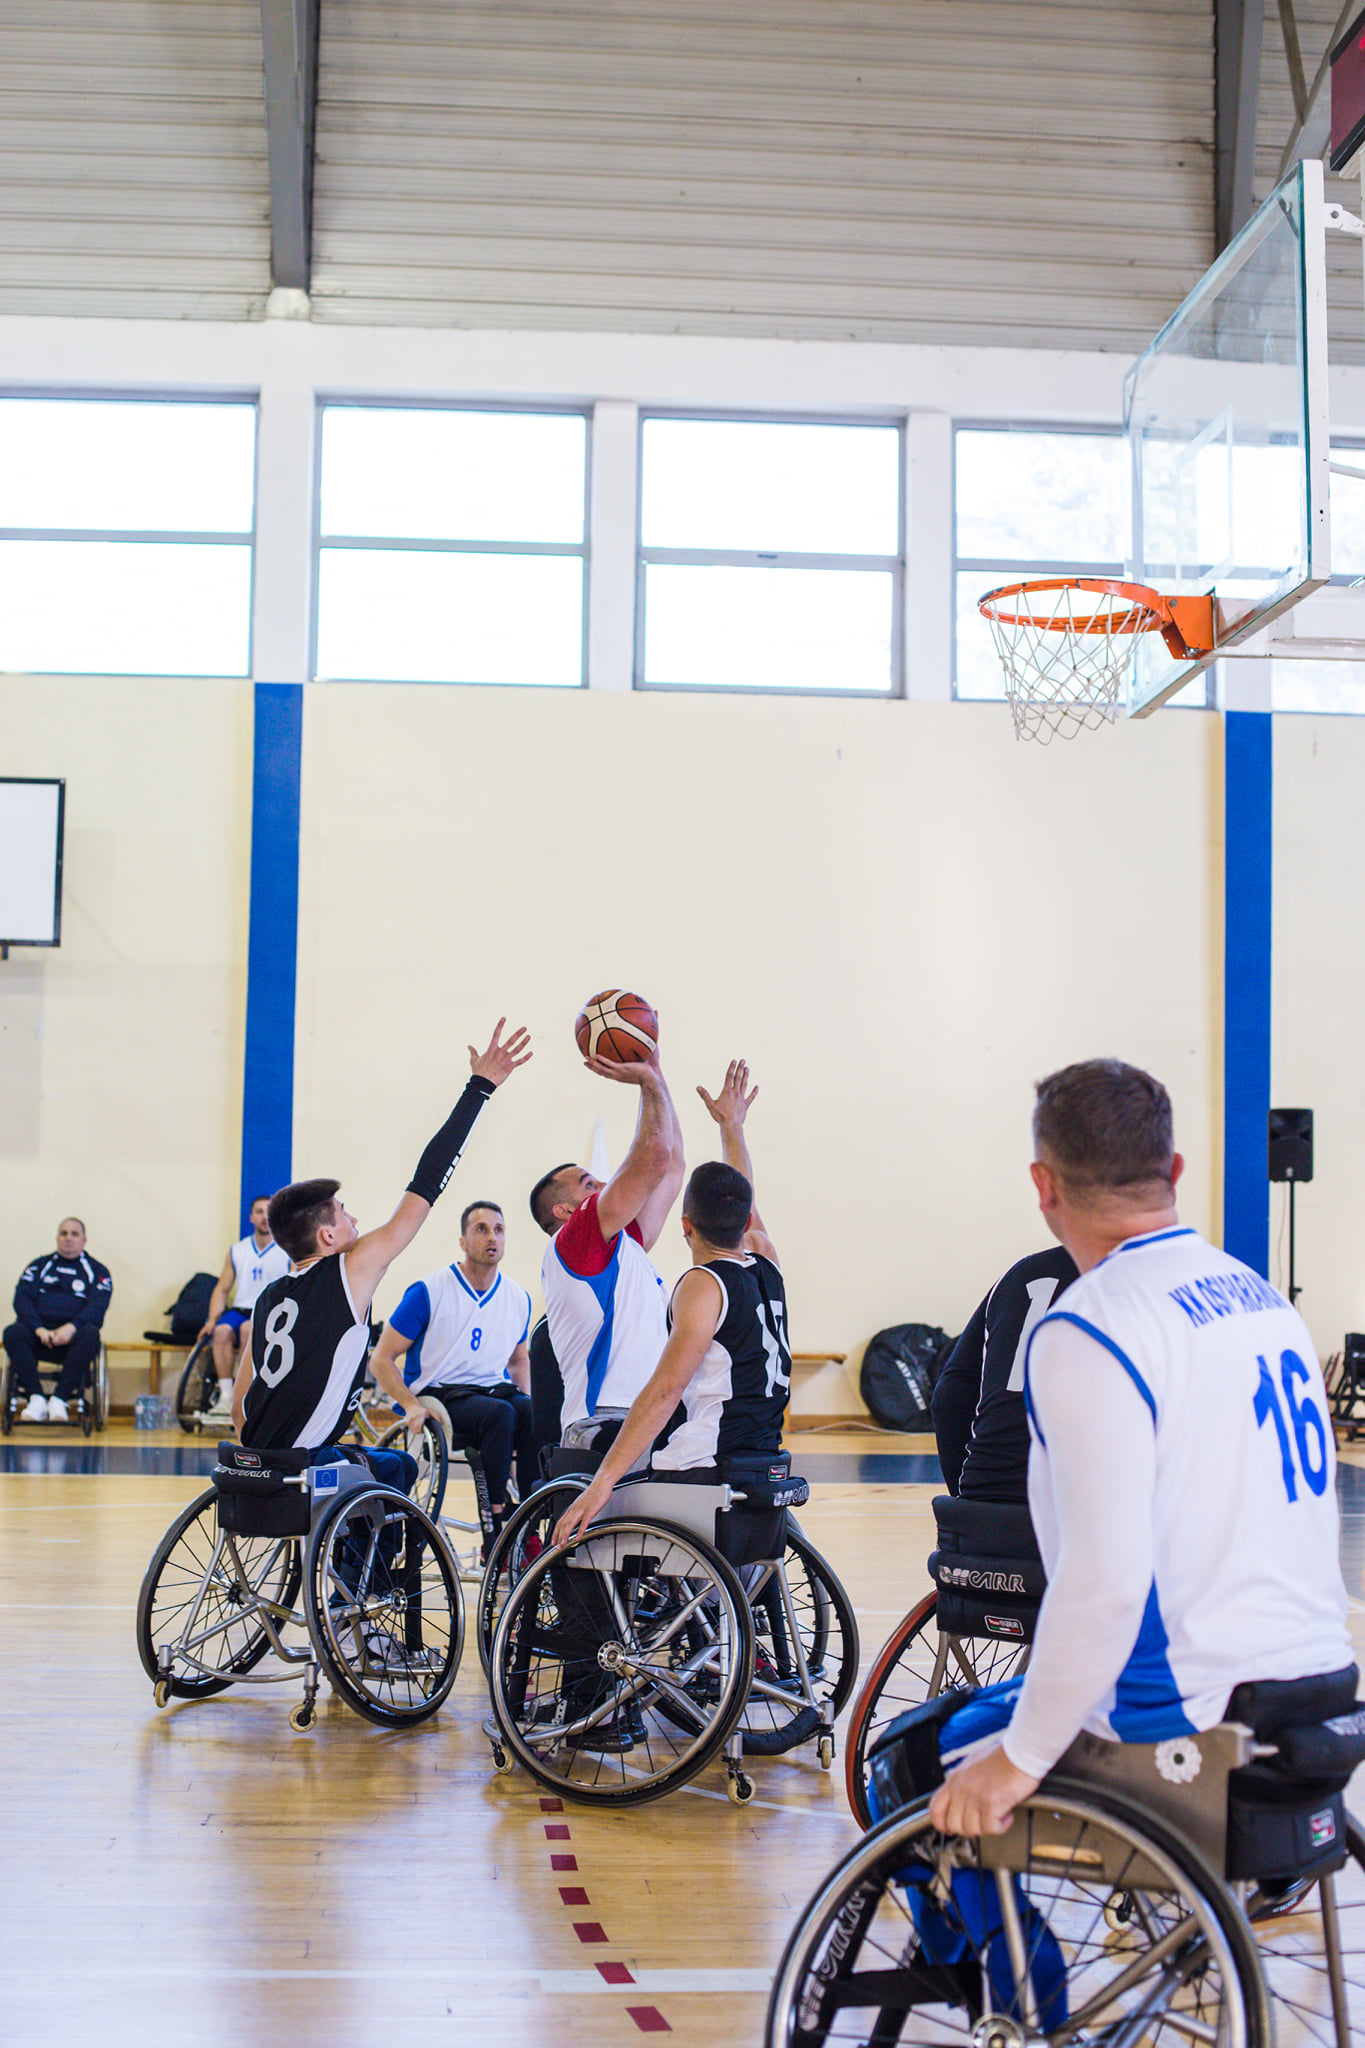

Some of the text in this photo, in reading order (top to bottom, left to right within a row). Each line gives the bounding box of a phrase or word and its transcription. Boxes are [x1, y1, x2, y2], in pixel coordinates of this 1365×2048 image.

[252, 1267, 262, 1281] 11
[259, 1297, 299, 1389] 8
[470, 1327, 482, 1352] 8
[1252, 1349, 1328, 1504] 16
